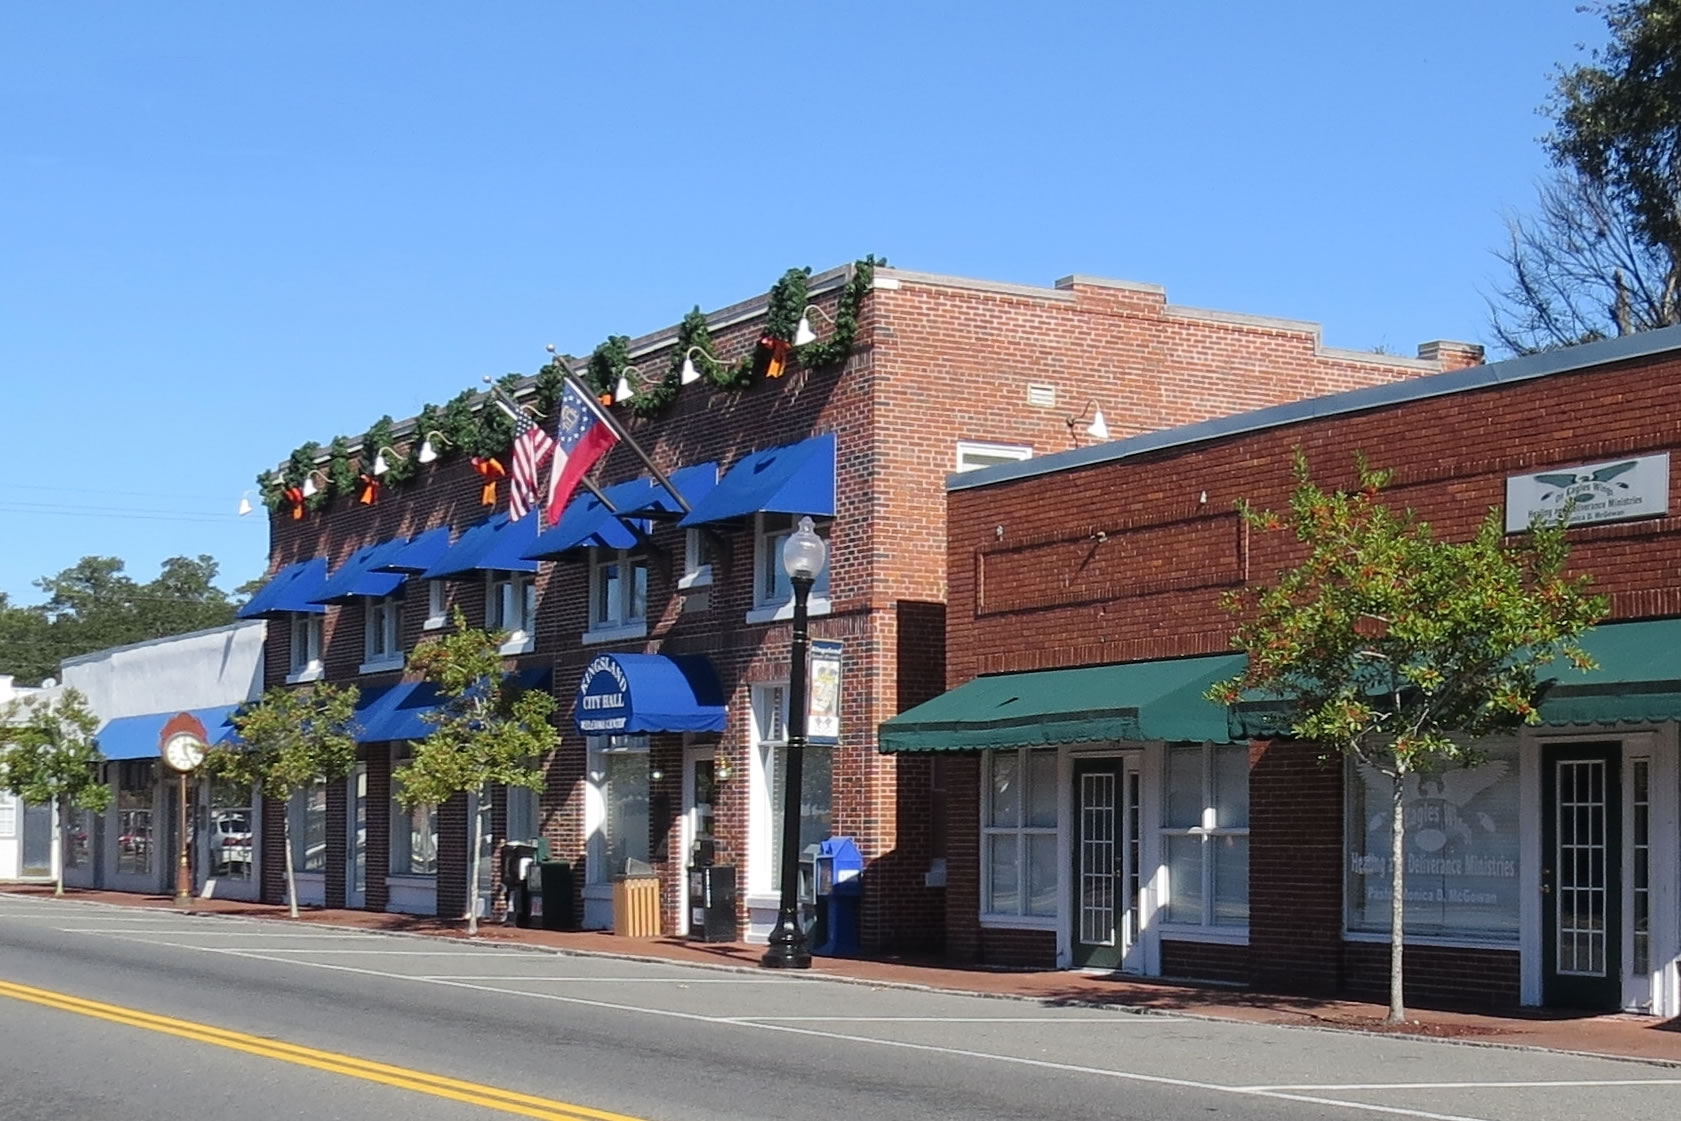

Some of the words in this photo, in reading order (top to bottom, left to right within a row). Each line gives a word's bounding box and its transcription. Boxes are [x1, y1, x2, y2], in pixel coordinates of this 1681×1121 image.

[1566, 483, 1590, 495] Eagles
[1608, 496, 1643, 507] Ministries
[580, 656, 627, 696] KINGSLAND
[583, 695, 601, 710] CITY
[602, 693, 625, 709] HALL
[1351, 852, 1386, 878] Healing
[1408, 853, 1462, 875] Deliverance
[1465, 855, 1515, 877] Ministries
[1449, 889, 1497, 903] McGowan
